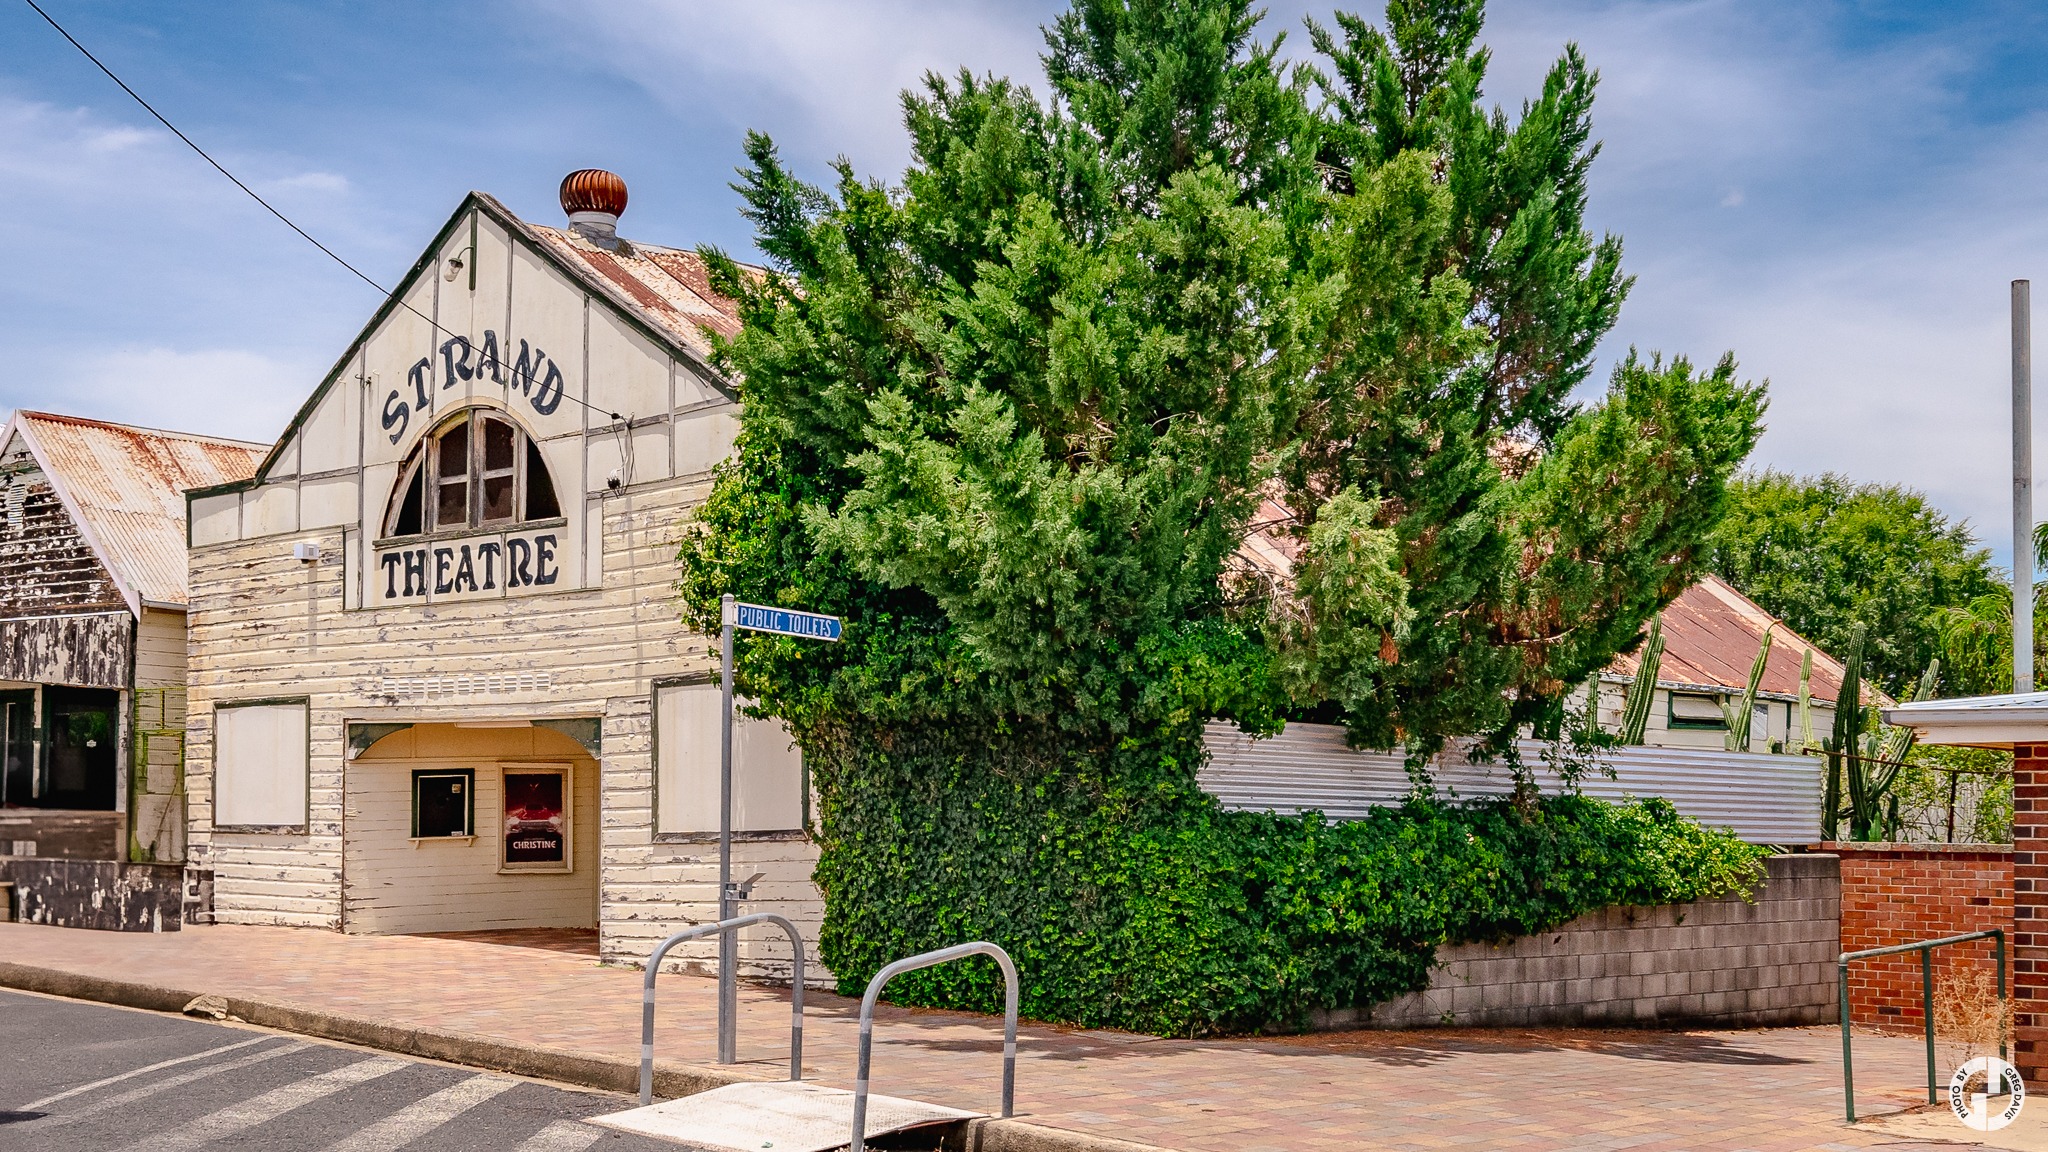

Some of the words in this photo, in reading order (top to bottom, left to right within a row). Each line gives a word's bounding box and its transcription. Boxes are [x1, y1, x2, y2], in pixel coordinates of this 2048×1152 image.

[382, 330, 563, 445] STRAND
[381, 535, 558, 598] THEATRE
[740, 607, 781, 629] PUBLIC
[788, 614, 832, 637] TOILETS
[513, 841, 556, 849] CHRISTINE
